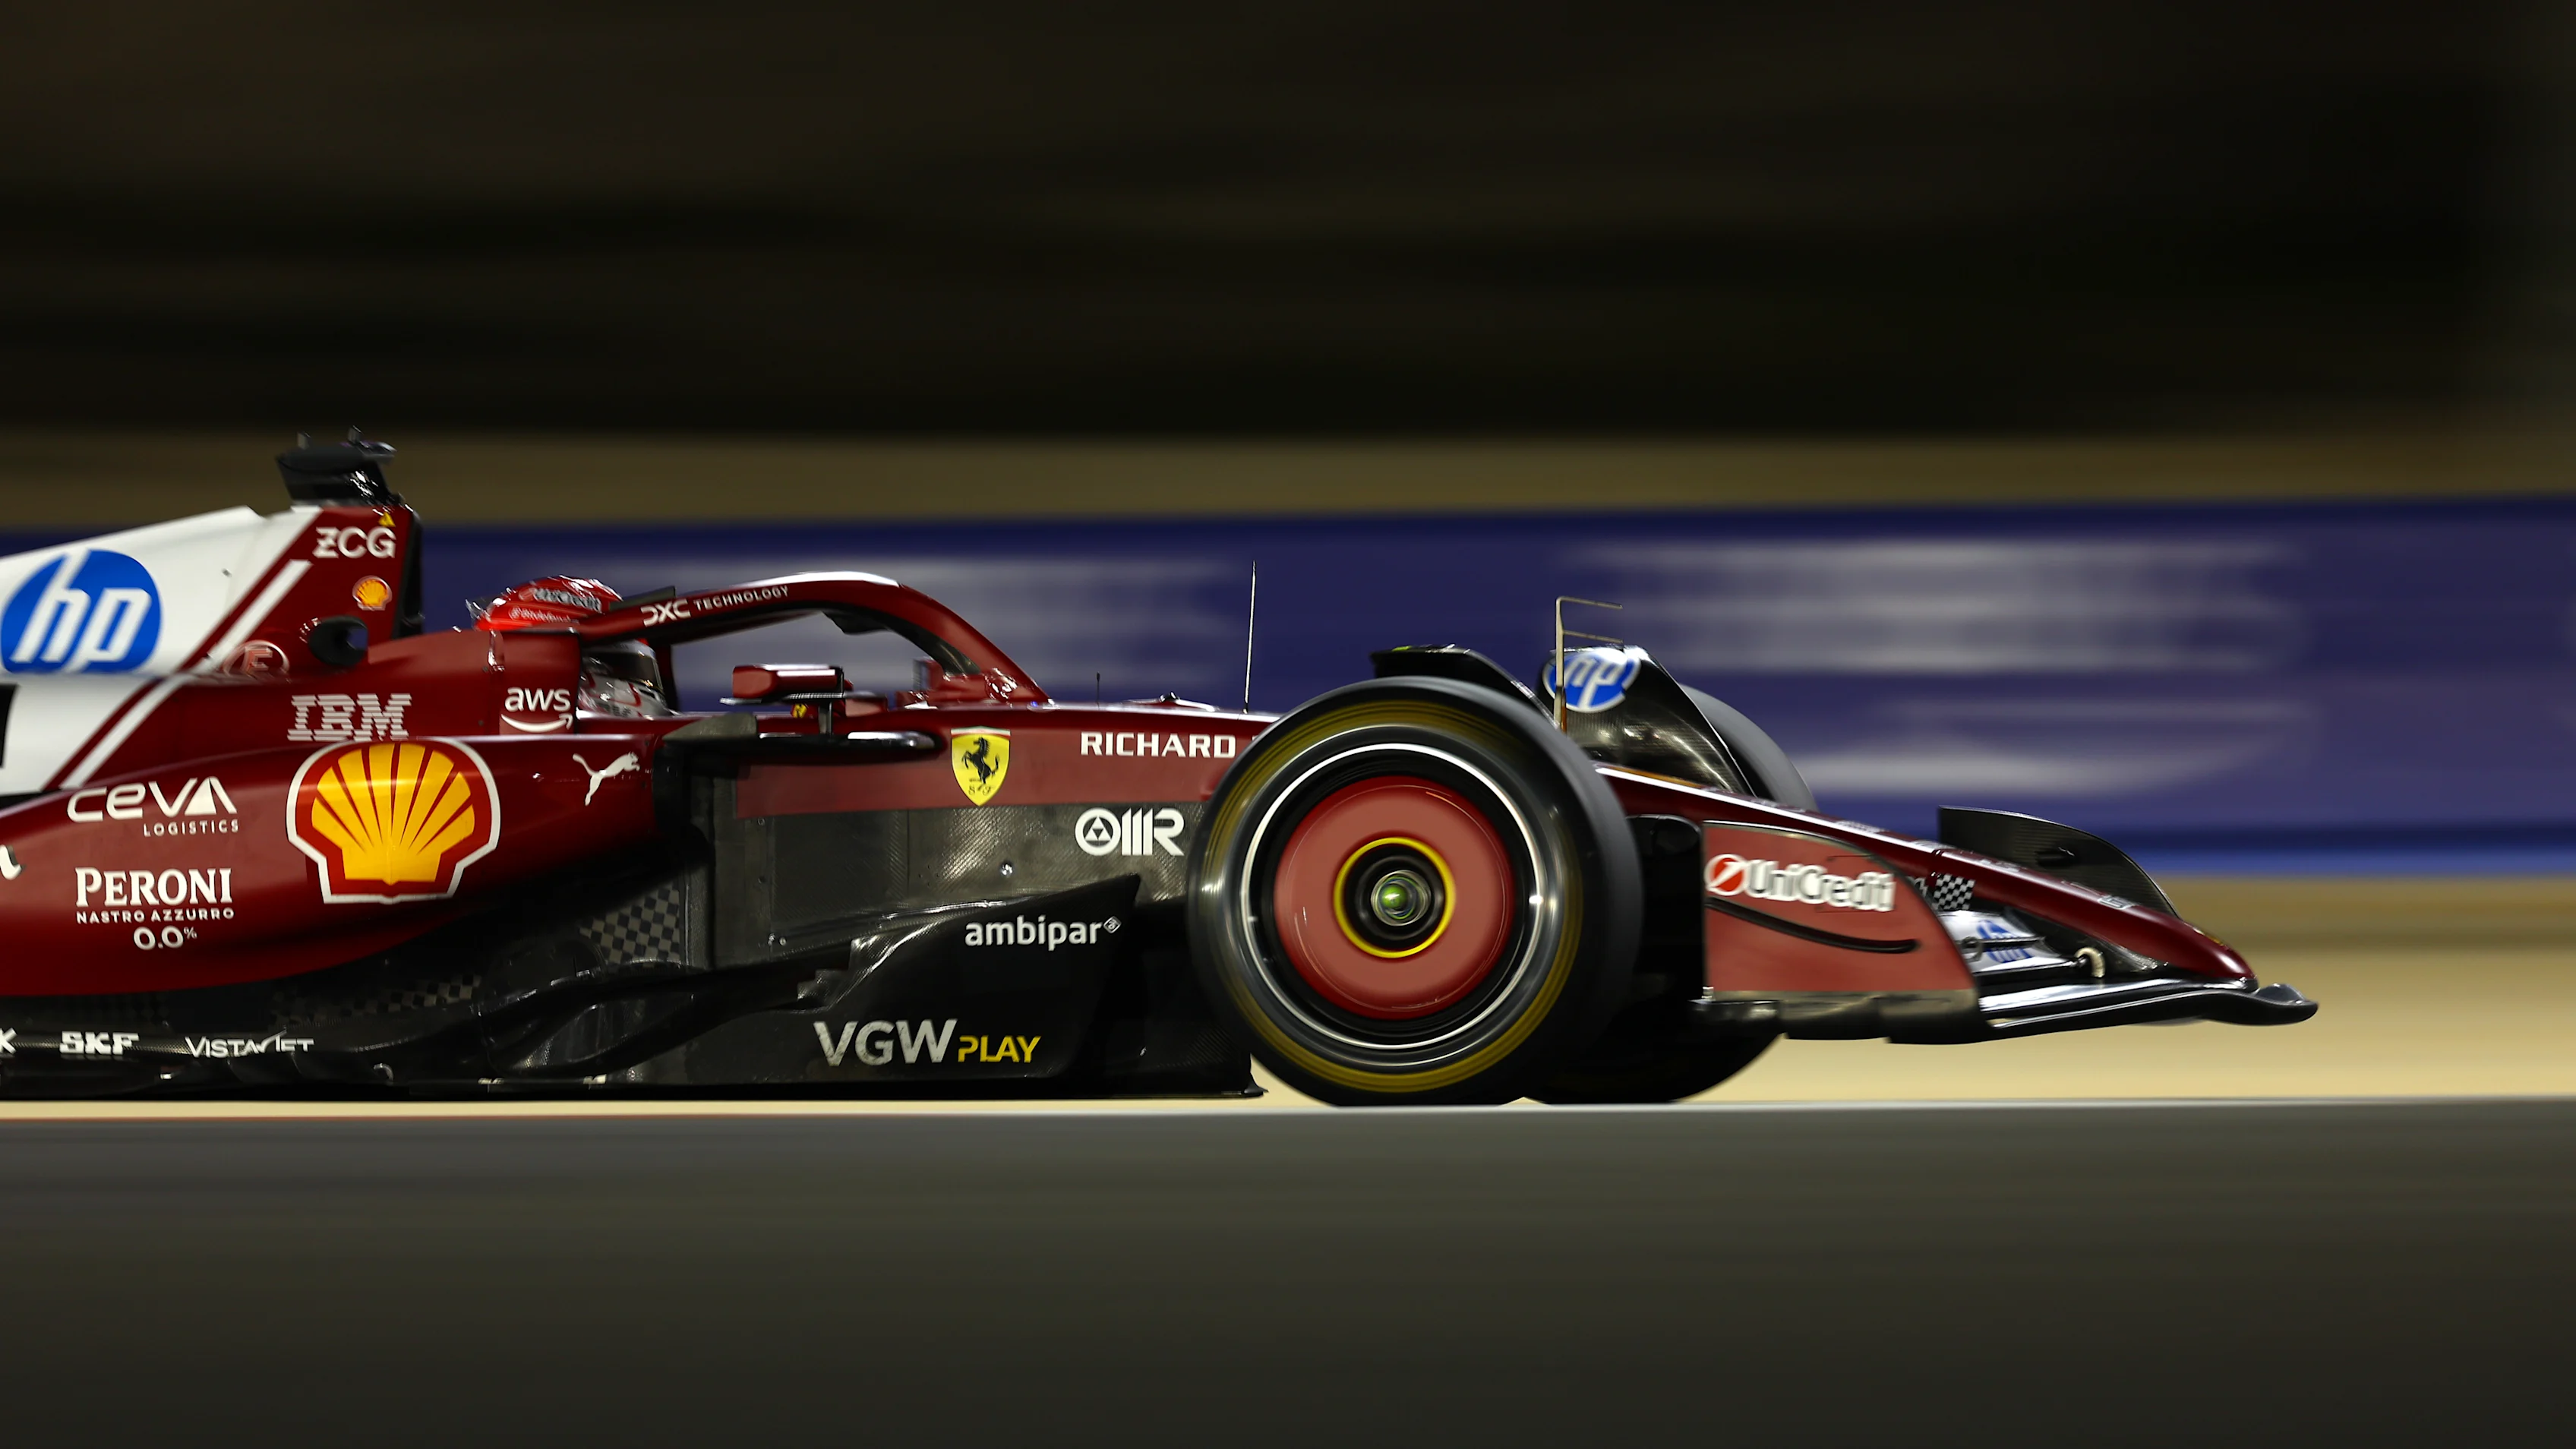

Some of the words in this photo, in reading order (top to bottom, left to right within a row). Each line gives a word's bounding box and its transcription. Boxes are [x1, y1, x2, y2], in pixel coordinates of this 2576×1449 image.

[9, 548, 152, 674] hp
[641, 598, 691, 627] DXC
[693, 585, 788, 611] TECHNOLOGY
[287, 693, 412, 741] IBM
[505, 687, 571, 712] aws
[1081, 731, 1236, 758] RICHARD
[144, 819, 238, 836] LOGISTICS
[75, 867, 232, 907] PERONI
[1746, 859, 1896, 911] UniCredit
[77, 910, 145, 924] NASTRO
[151, 907, 235, 922] AZZURRO
[964, 914, 1103, 951] ambipar
[133, 925, 197, 950] 0.0%
[59, 1031, 140, 1055] SKF
[813, 1018, 958, 1066] VGW
[958, 1035, 1041, 1062] PLAY
